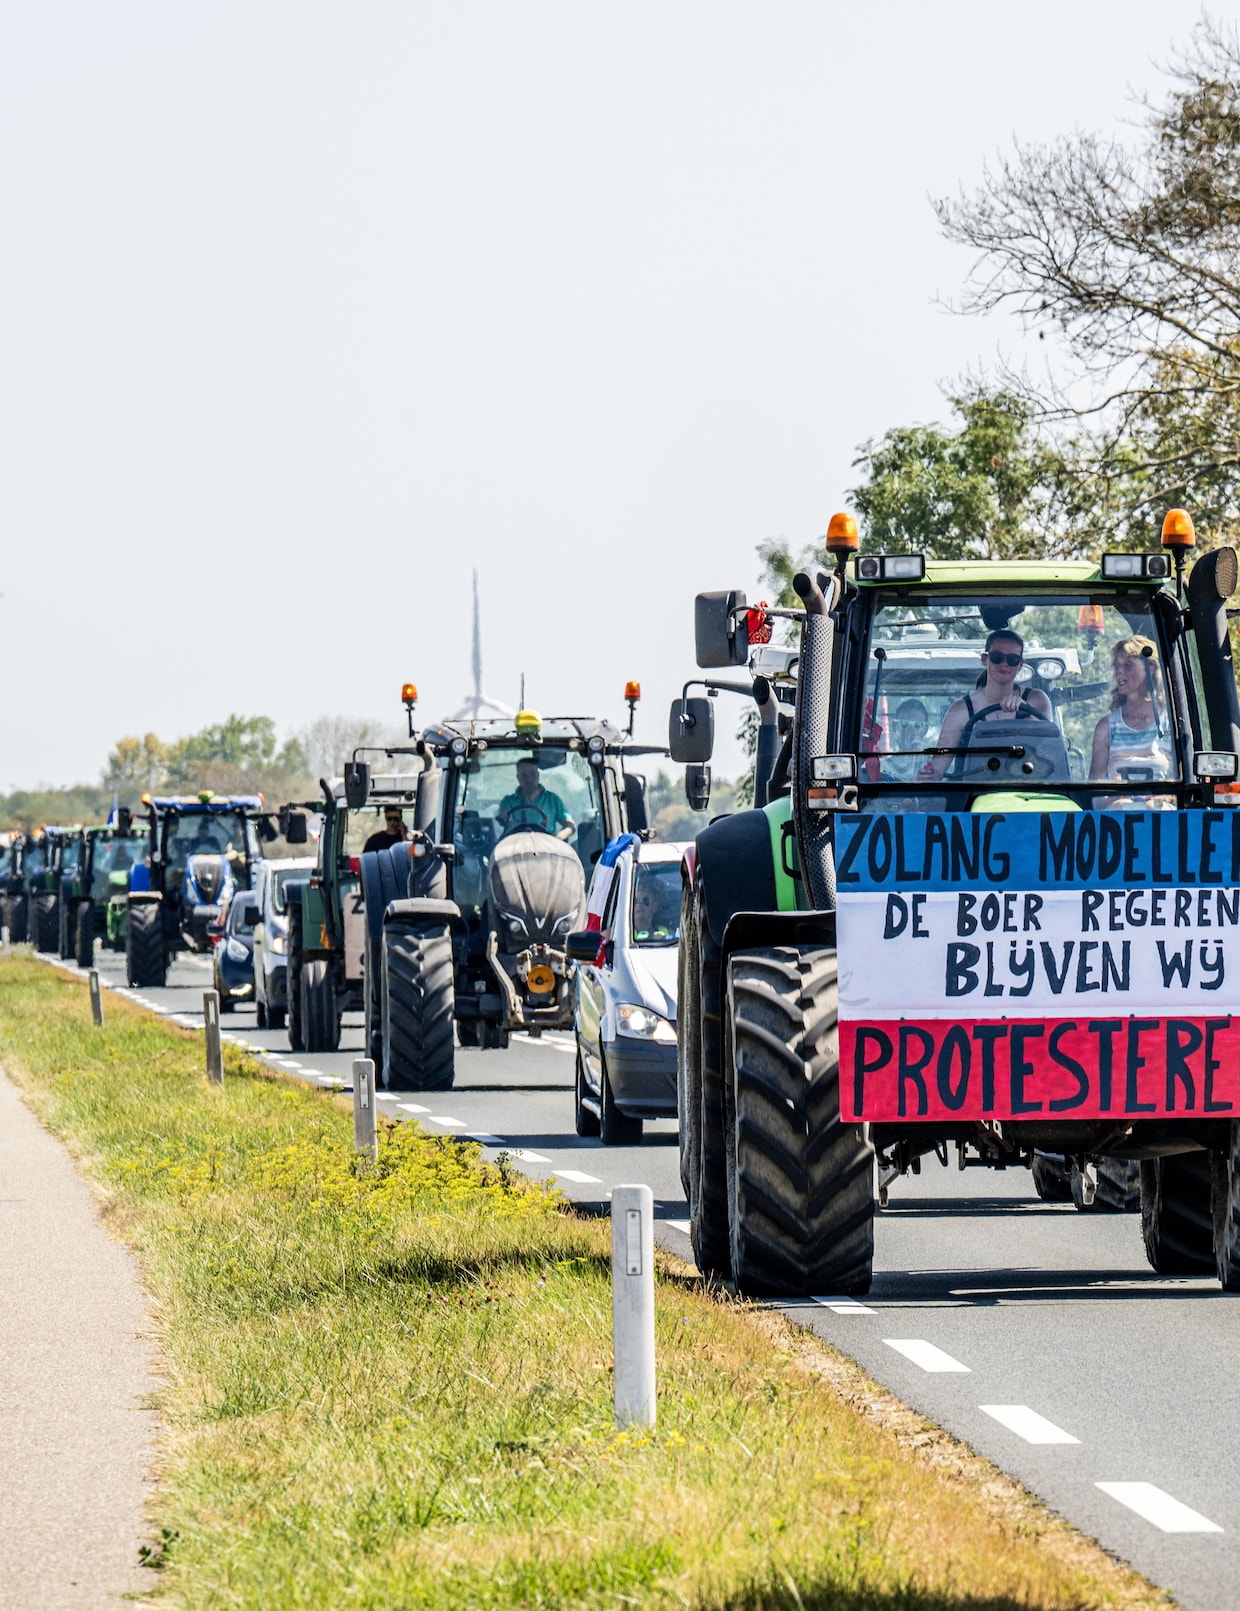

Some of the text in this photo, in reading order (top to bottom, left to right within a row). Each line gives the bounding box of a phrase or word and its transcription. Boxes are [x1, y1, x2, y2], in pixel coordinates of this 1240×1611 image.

[836, 814, 1010, 883] ZOLANG
[883, 889, 1240, 939] DE BOER REGEREN
